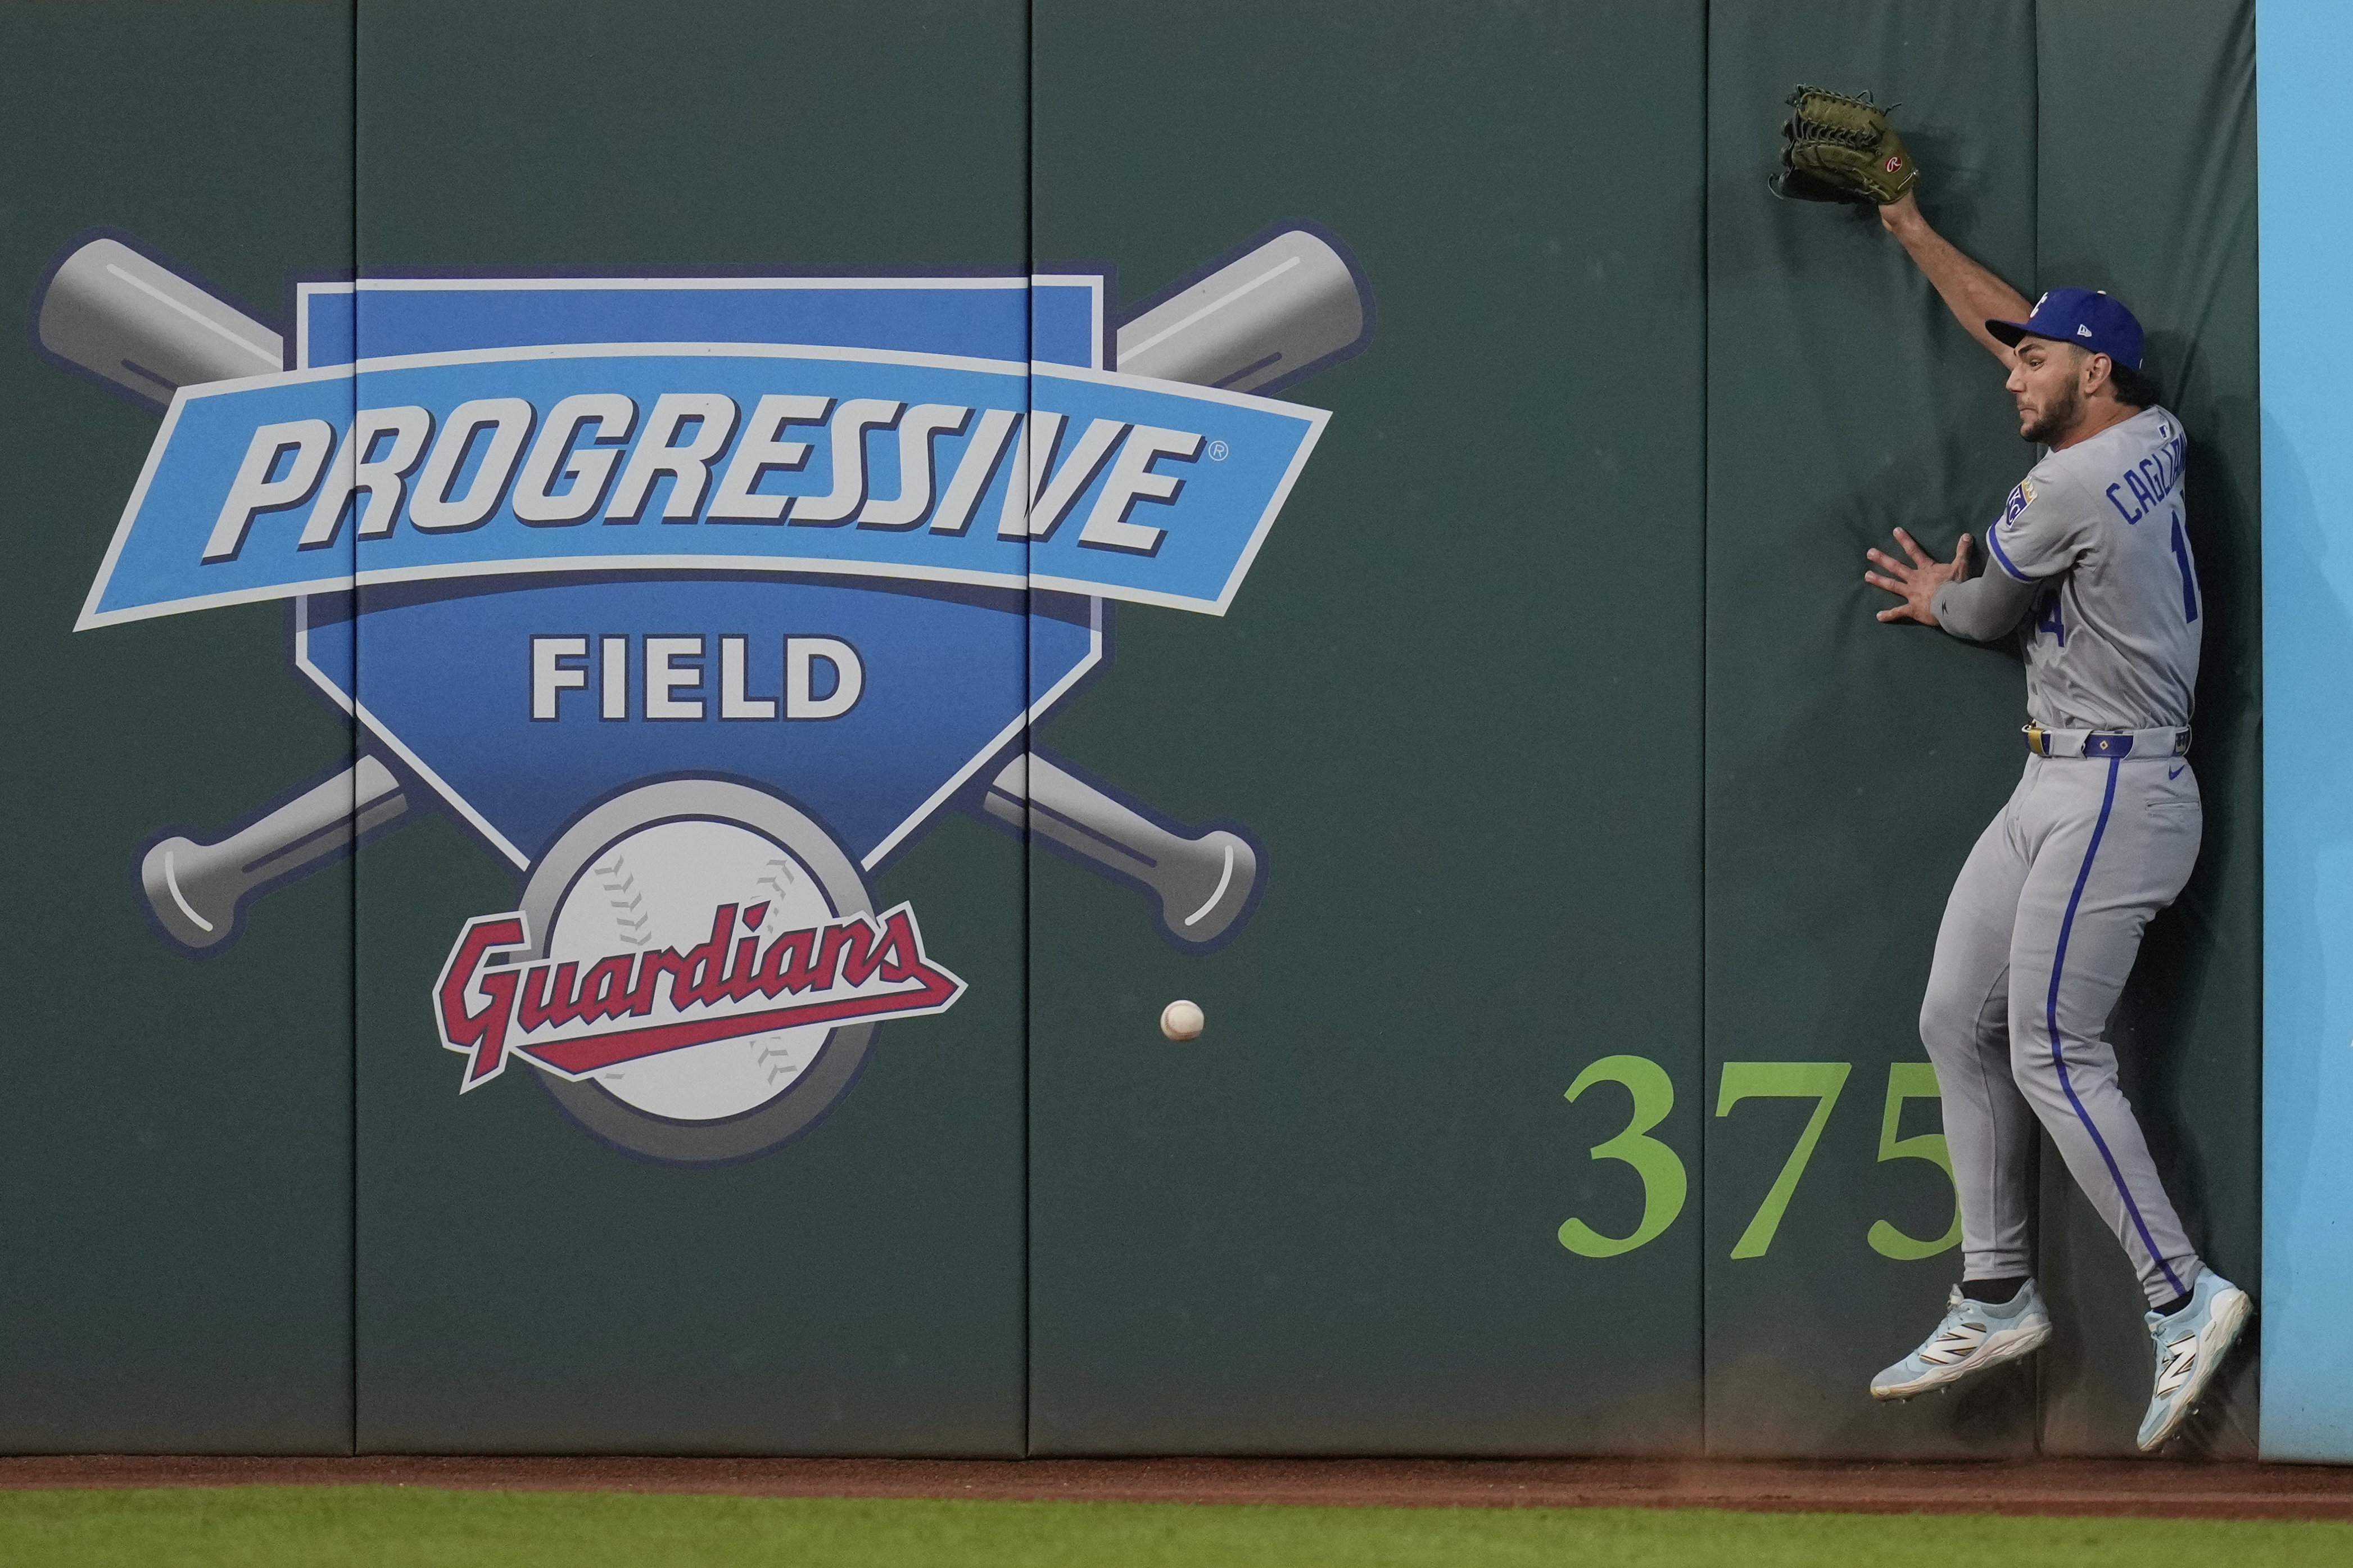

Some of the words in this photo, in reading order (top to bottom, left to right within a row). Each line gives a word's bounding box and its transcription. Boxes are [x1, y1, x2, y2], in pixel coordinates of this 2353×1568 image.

[200, 393, 1207, 567] PROGRESSIVE
[530, 633, 866, 722] FIELD
[436, 899, 963, 1088] Guardians
[1557, 1054, 1963, 1261] 375
